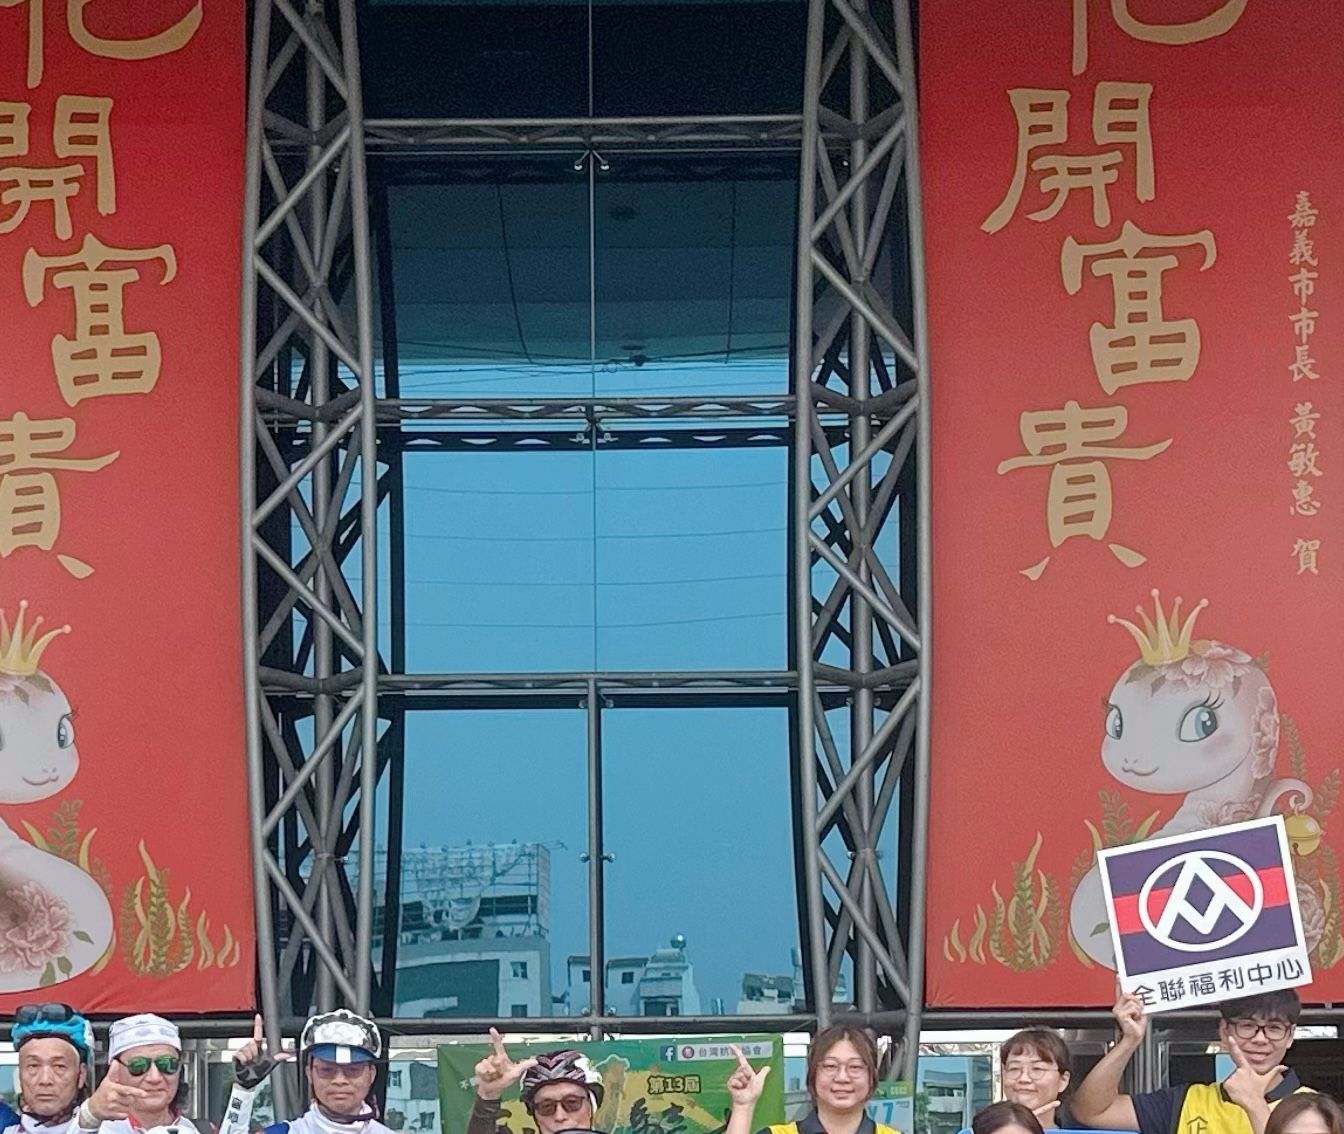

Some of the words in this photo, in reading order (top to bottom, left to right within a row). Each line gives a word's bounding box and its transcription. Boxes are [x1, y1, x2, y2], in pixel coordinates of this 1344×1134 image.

[1287, 190, 1320, 383] 嘉義市市長
[1287, 402, 1323, 516] 黃敏惠
[1291, 537, 1321, 575] 賀
[1132, 957, 1305, 1007] 全聯福利中心
[699, 1044, 762, 1058] 台灣抗協會
[648, 1075, 701, 1095] 第13屆
